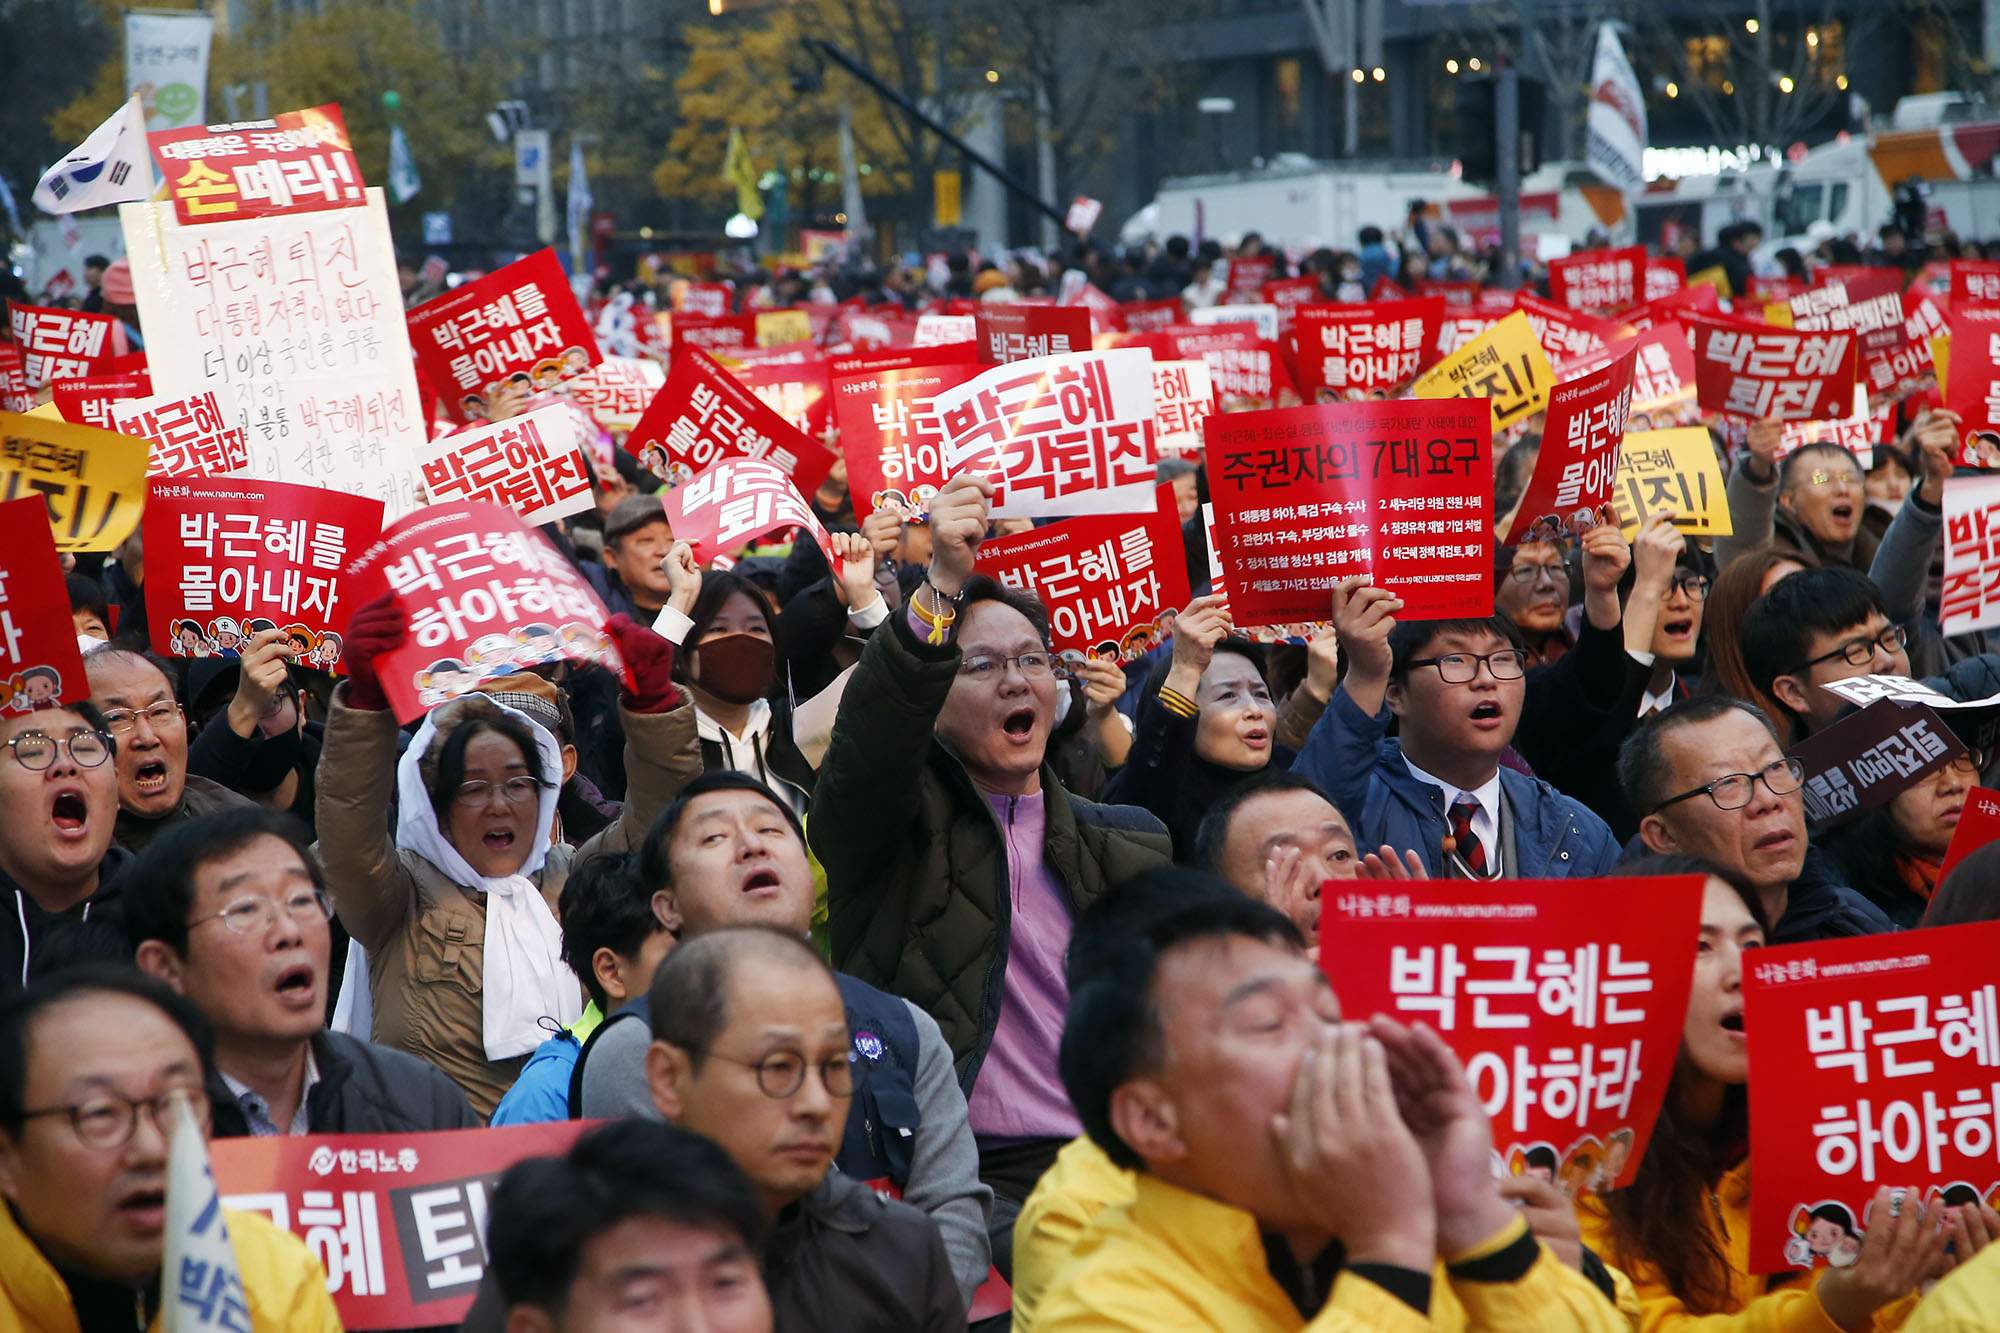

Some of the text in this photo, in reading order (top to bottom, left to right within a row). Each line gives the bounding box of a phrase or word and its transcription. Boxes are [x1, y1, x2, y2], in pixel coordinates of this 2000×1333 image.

[159, 134, 248, 160] 대통령은
[182, 225, 367, 300] 박근혜 퇴진
[11, 309, 108, 358] 박근혜
[196, 295, 261, 340] 대통령
[267, 290, 329, 332] 자격이
[335, 289, 382, 323] 없다
[432, 282, 550, 350] 박근혜를
[1321, 318, 1424, 355] 박근혜를
[24, 353, 90, 388] 퇴진
[204, 344, 230, 383] 더
[237, 340, 273, 378] 이상
[342, 326, 382, 364] 우롱
[450, 317, 564, 390] 몰아내자
[1323, 349, 1421, 387] 몰아내자
[1449, 345, 1501, 384] 박근혜
[1706, 329, 1849, 377] 박근혜
[842, 380, 878, 394] 나눔문화
[943, 359, 1115, 443] 박근혜
[1724, 376, 1823, 419] 퇴진
[117, 391, 226, 448] 박근혜
[690, 382, 799, 475] 박근혜를
[1154, 398, 1214, 437] 퇴진
[1568, 383, 1630, 454] 박근혜를
[294, 438, 336, 477] 심판
[344, 437, 387, 469] 하자
[420, 419, 550, 497] 박근혜
[950, 418, 1156, 508] 즉각퇴진
[1223, 438, 1480, 492] 주권자의 7대 요구
[1619, 448, 1675, 474] 박근혜
[153, 485, 265, 501] 나눔문화 www.nanum.com
[1229, 512, 1236, 525] 1
[1239, 508, 1271, 524] 대통령
[1321, 502, 1343, 517] 구속
[1344, 499, 1366, 514] 수사
[1378, 495, 1482, 511] 2 새누리당 의원 전원 사퇴
[1612, 471, 1710, 531] 퇴진!
[180, 511, 347, 571] 박근혜를
[716, 491, 820, 545] 퇴진
[1232, 535, 1239, 548] 3
[1242, 532, 1275, 547] 관련자
[1347, 523, 1370, 538] 몰수
[1380, 519, 1482, 535] 4 정경유착 재벌 기업 처벌
[974, 532, 1069, 562] 눔문화 www.nanum.com
[999, 526, 1154, 599] 박근혜를
[1235, 558, 1243, 571] 5
[1269, 556, 1289, 570] 검찰
[1291, 552, 1312, 567] 청산
[1313, 552, 1325, 566] 및
[1326, 550, 1348, 565] 검찰
[1349, 548, 1372, 563] 개혁
[1382, 546, 1391, 560] 6
[1392, 545, 1418, 560] 박근혜
[1419, 545, 1436, 559] 정책
[179, 565, 339, 624] 몰아내자
[1048, 570, 1162, 647] 아내자
[1240, 581, 1248, 594] 7
[1310, 576, 1339, 591] 진실을
[408, 577, 606, 648] 하야하라
[1978, 799, 2000, 816] 나눔
[1338, 895, 1537, 919] 나눔문화 www.nanum.com
[1391, 942, 1654, 1030] 박근혜는
[1754, 953, 1931, 984] 나눔문화 www.nanum.com
[1805, 984, 2000, 1084] 박근혜
[1466, 1039, 1643, 1133] 야하라
[338, 1148, 420, 1174] 한국노총
